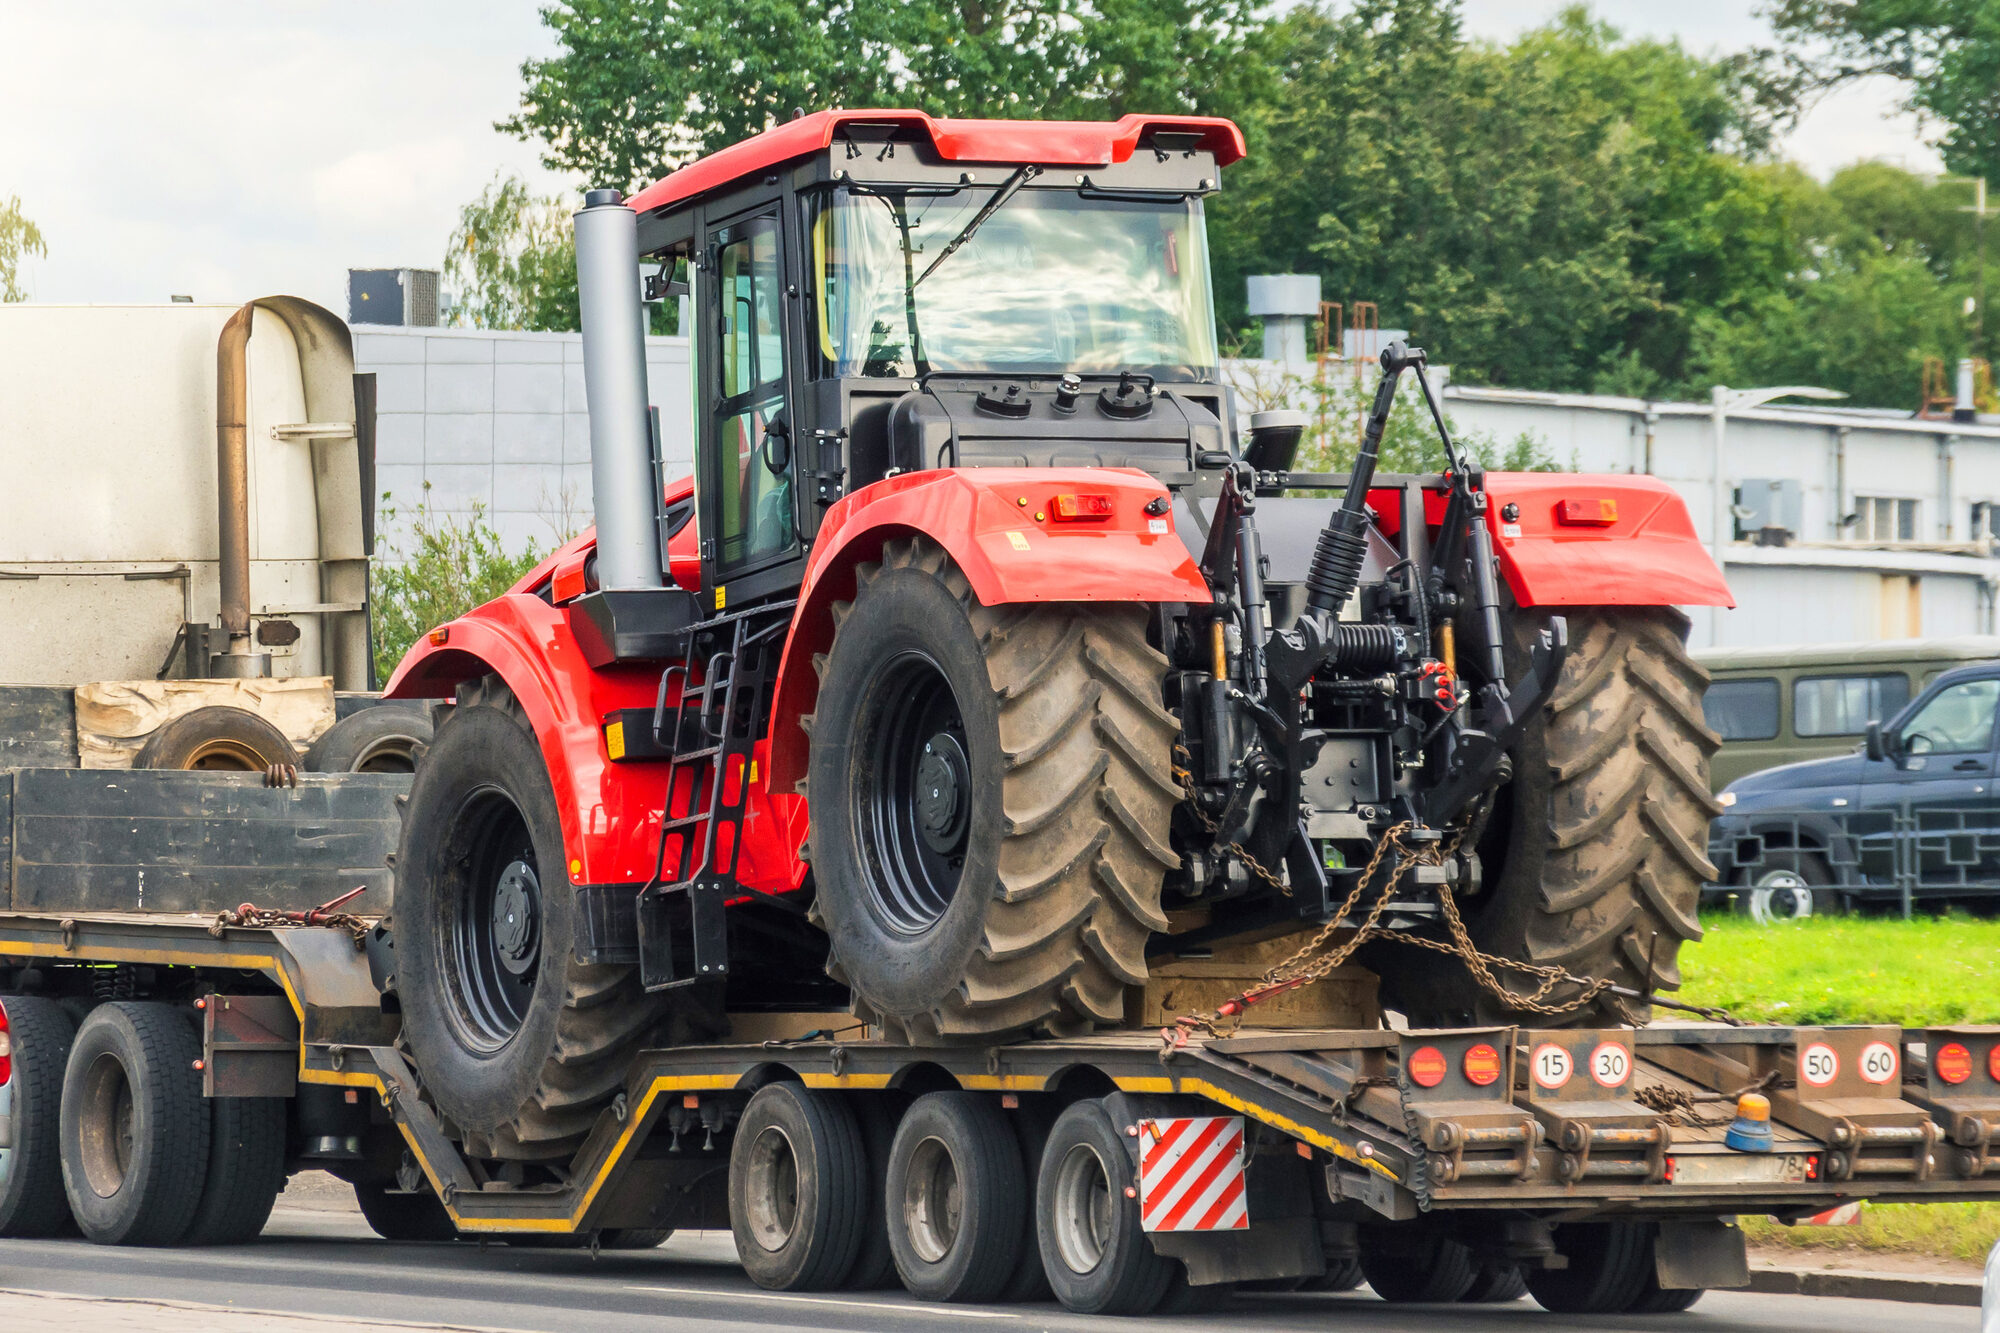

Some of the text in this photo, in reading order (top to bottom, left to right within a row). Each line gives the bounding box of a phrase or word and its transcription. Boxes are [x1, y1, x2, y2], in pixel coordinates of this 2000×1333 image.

[1542, 1054, 1564, 1076] 15
[1599, 1054, 1624, 1076] 30
[1808, 1054, 1833, 1075] 50
[1867, 1052, 1891, 1073] 60
[1777, 1155, 1797, 1174] 78
